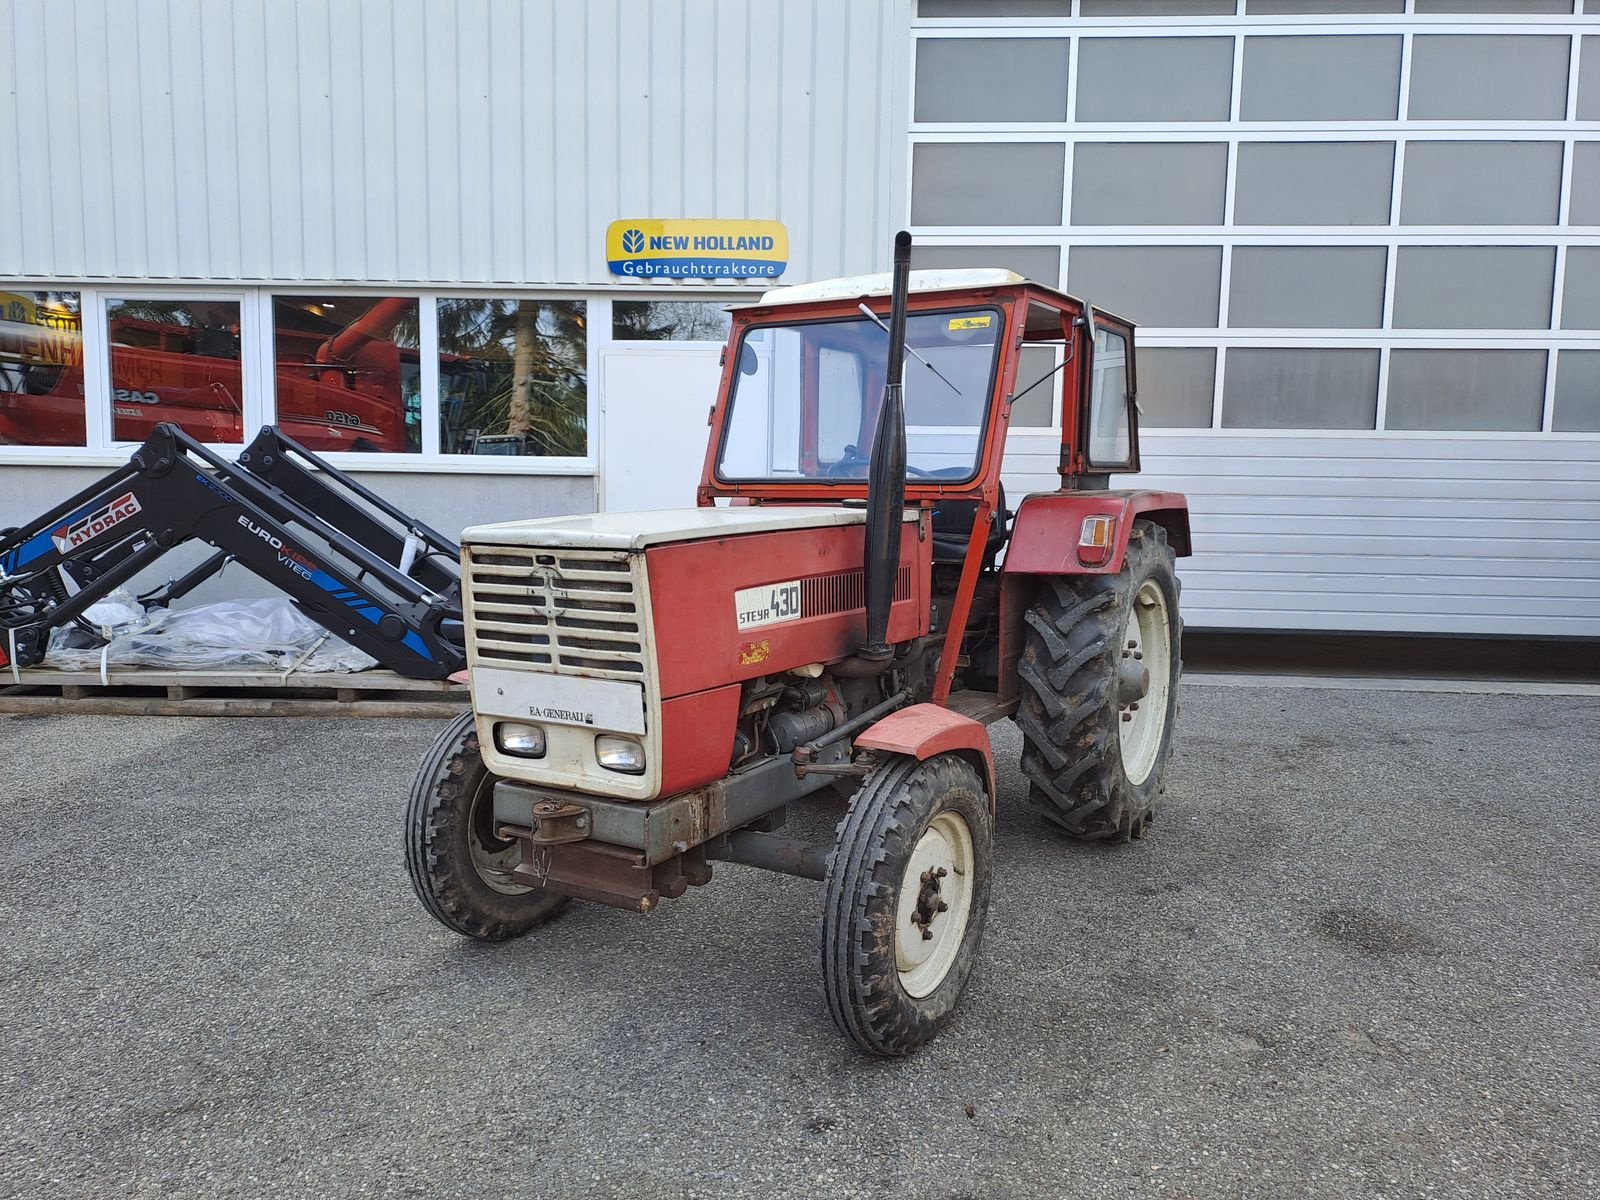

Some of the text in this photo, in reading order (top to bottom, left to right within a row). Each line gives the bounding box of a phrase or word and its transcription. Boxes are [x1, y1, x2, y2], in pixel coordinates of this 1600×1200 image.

[650, 236, 774, 251] NEW HOLLAND
[622, 261, 775, 275] Gebrauchttraktore
[70, 503, 136, 546] HYDRAC
[277, 551, 313, 581] VITEC
[739, 586, 799, 624] STEYR 430
